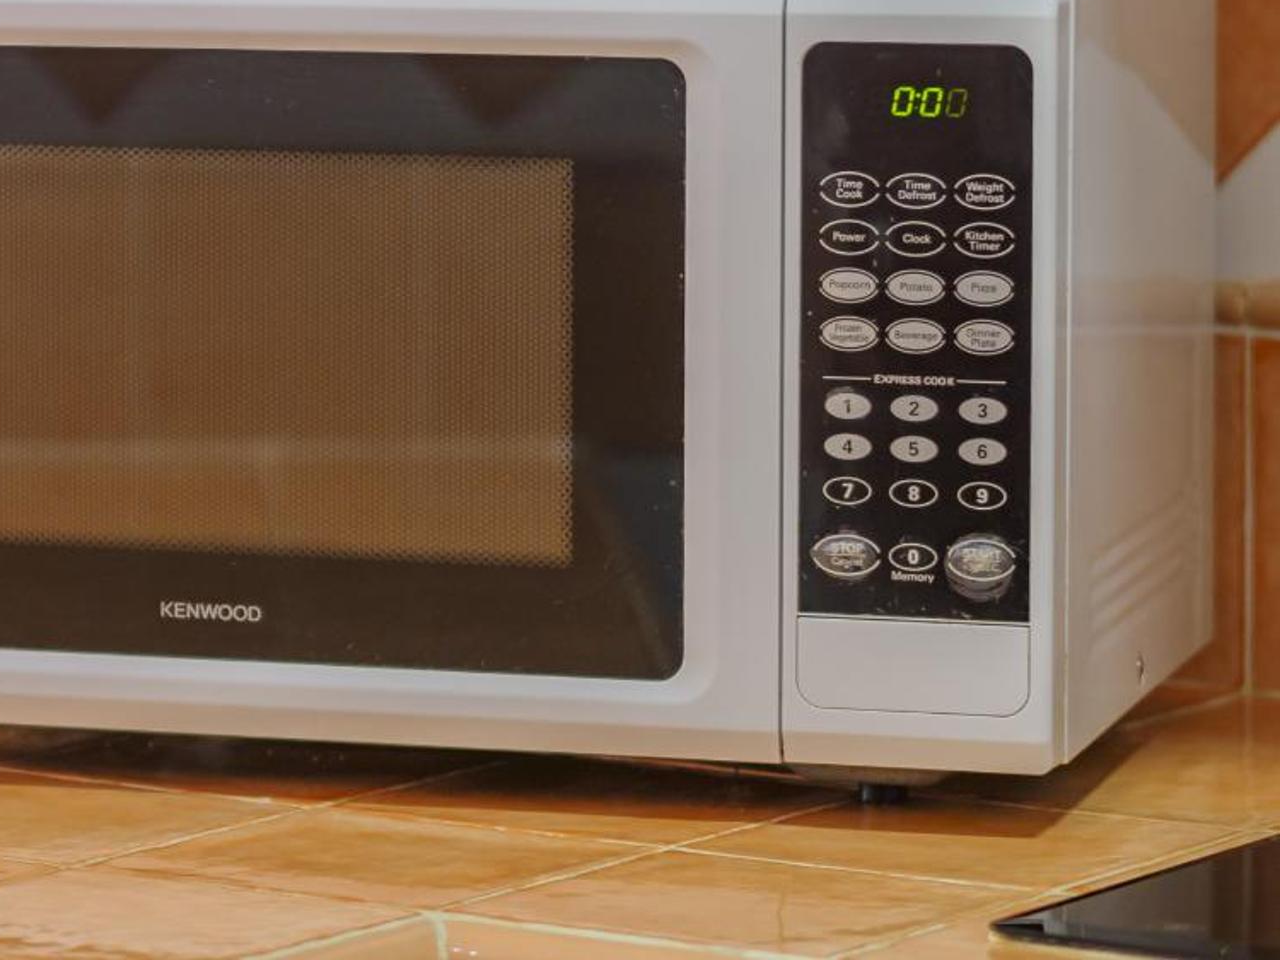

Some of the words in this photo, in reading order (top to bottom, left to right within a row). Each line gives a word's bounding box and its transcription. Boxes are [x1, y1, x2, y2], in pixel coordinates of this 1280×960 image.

[836, 178, 863, 189] Time
[904, 180, 931, 190] Time
[966, 182, 1004, 193] Weight
[836, 189, 863, 200] Cook
[898, 190, 936, 201] Defrost
[966, 193, 1005, 204] Defrost
[832, 231, 866, 242] Power
[902, 233, 931, 244] Clock
[965, 231, 1004, 241] Kitchen
[969, 241, 1001, 252] Timer
[829, 279, 871, 291] Popcorn
[966, 328, 1001, 338] Dinner
[873, 374, 921, 385] EXPRESS
[923, 376, 956, 386] COOK
[843, 399, 851, 414] 1
[908, 401, 920, 416] 2
[977, 403, 988, 418] 3
[842, 439, 853, 454] 4
[908, 441, 919, 456] 5
[977, 444, 988, 459] 6
[841, 483, 854, 499] 7
[908, 485, 920, 501] 8
[976, 488, 988, 504] 9
[907, 549, 919, 565] 0
[890, 570, 935, 583] Memory
[160, 601, 262, 622] KENWOOD
